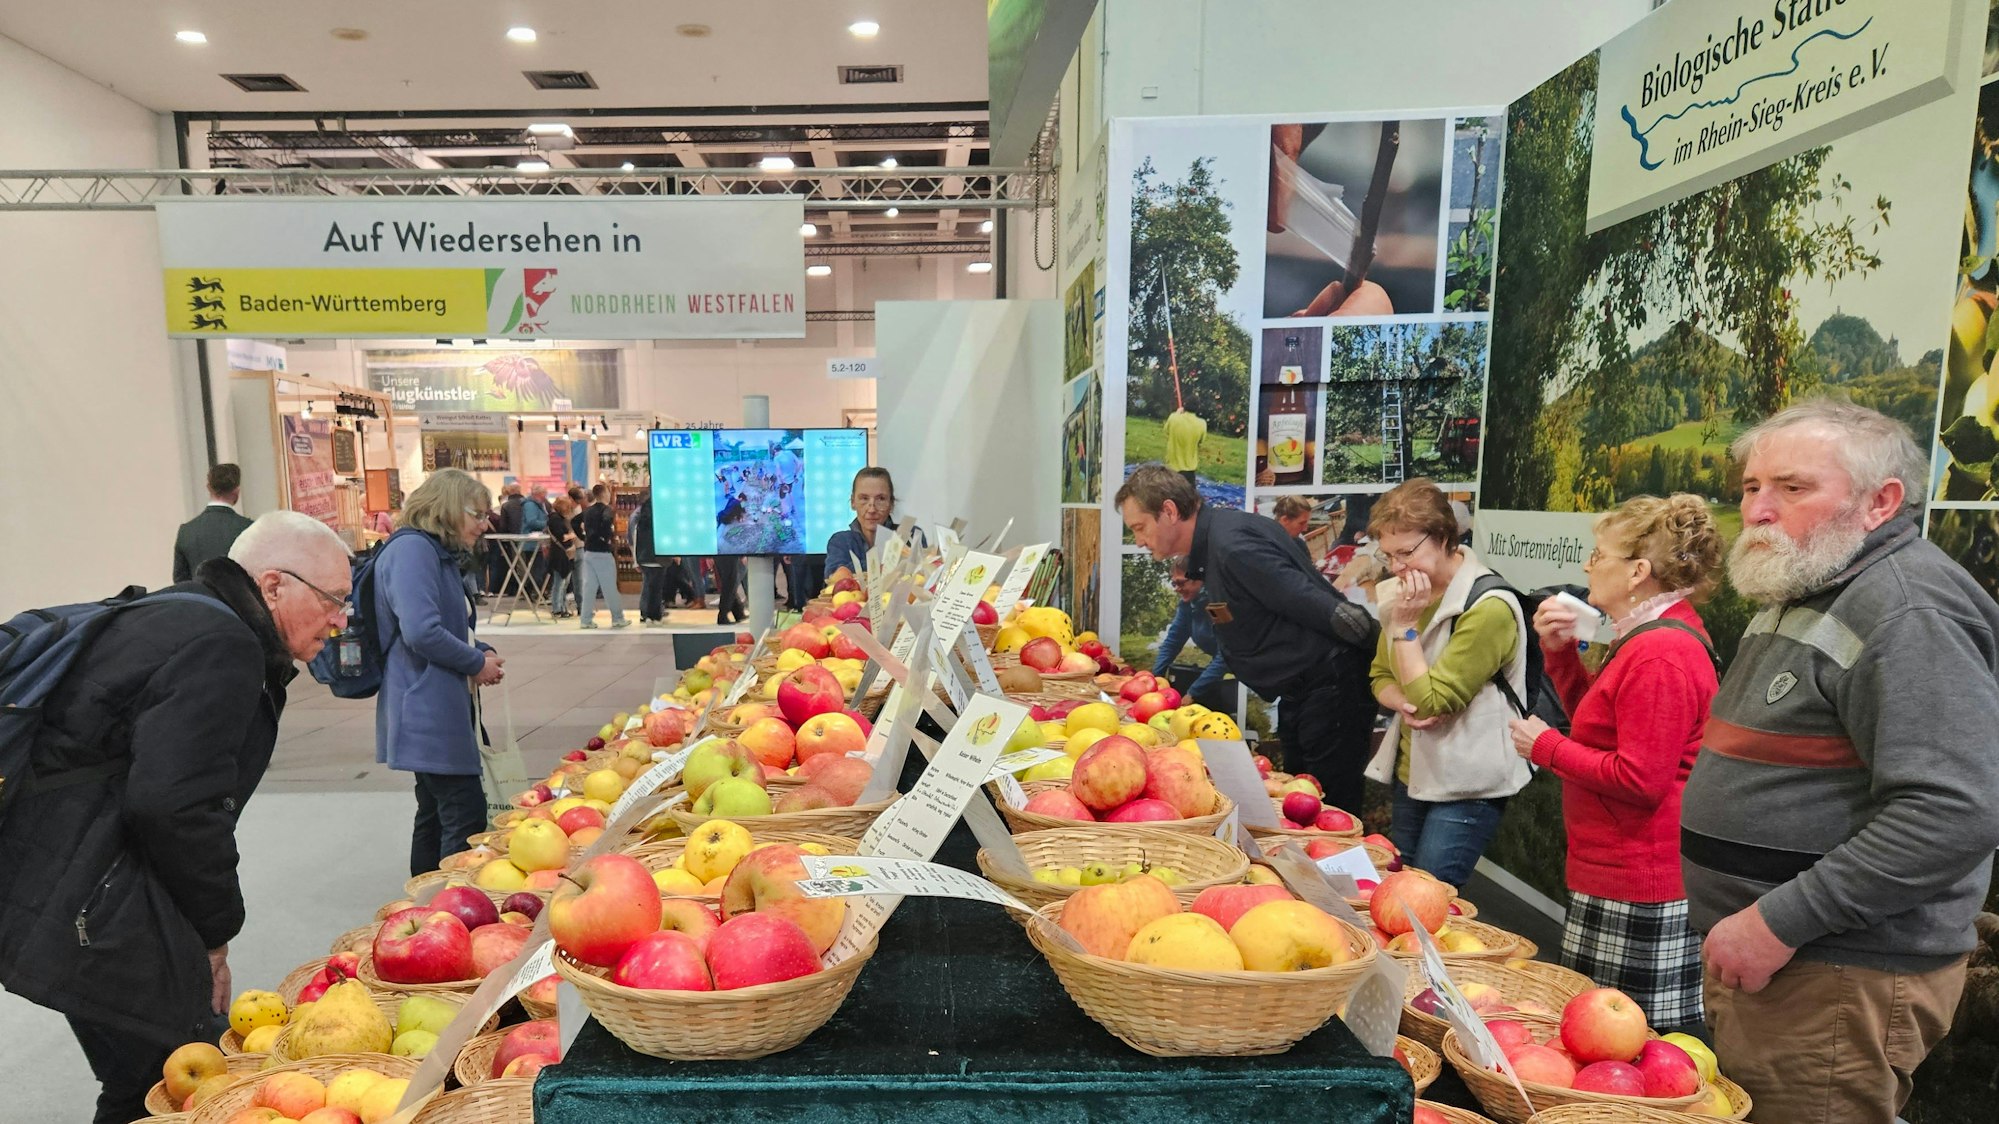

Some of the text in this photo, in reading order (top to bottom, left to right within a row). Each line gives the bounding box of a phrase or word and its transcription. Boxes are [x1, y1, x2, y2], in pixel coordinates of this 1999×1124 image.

[1641, 0, 1846, 109] Biologische Stat
[1673, 137, 1693, 166] im
[1697, 65, 1843, 155] Rhein-Sieg-Kreis
[323, 221, 641, 252] Auf Wiedersehen in
[239, 294, 447, 316] Baden-Württemberg
[571, 293, 794, 314] NORDRHEIN WESTFALEN
[831, 363, 866, 373] 5.2-120
[381, 375, 420, 387] Unsere
[382, 385, 478, 404] Flugkünstler
[699, 420, 725, 429] Jahre
[653, 435, 683, 447] LVR
[1487, 532, 1583, 569] Mit Sortenvielfalt
